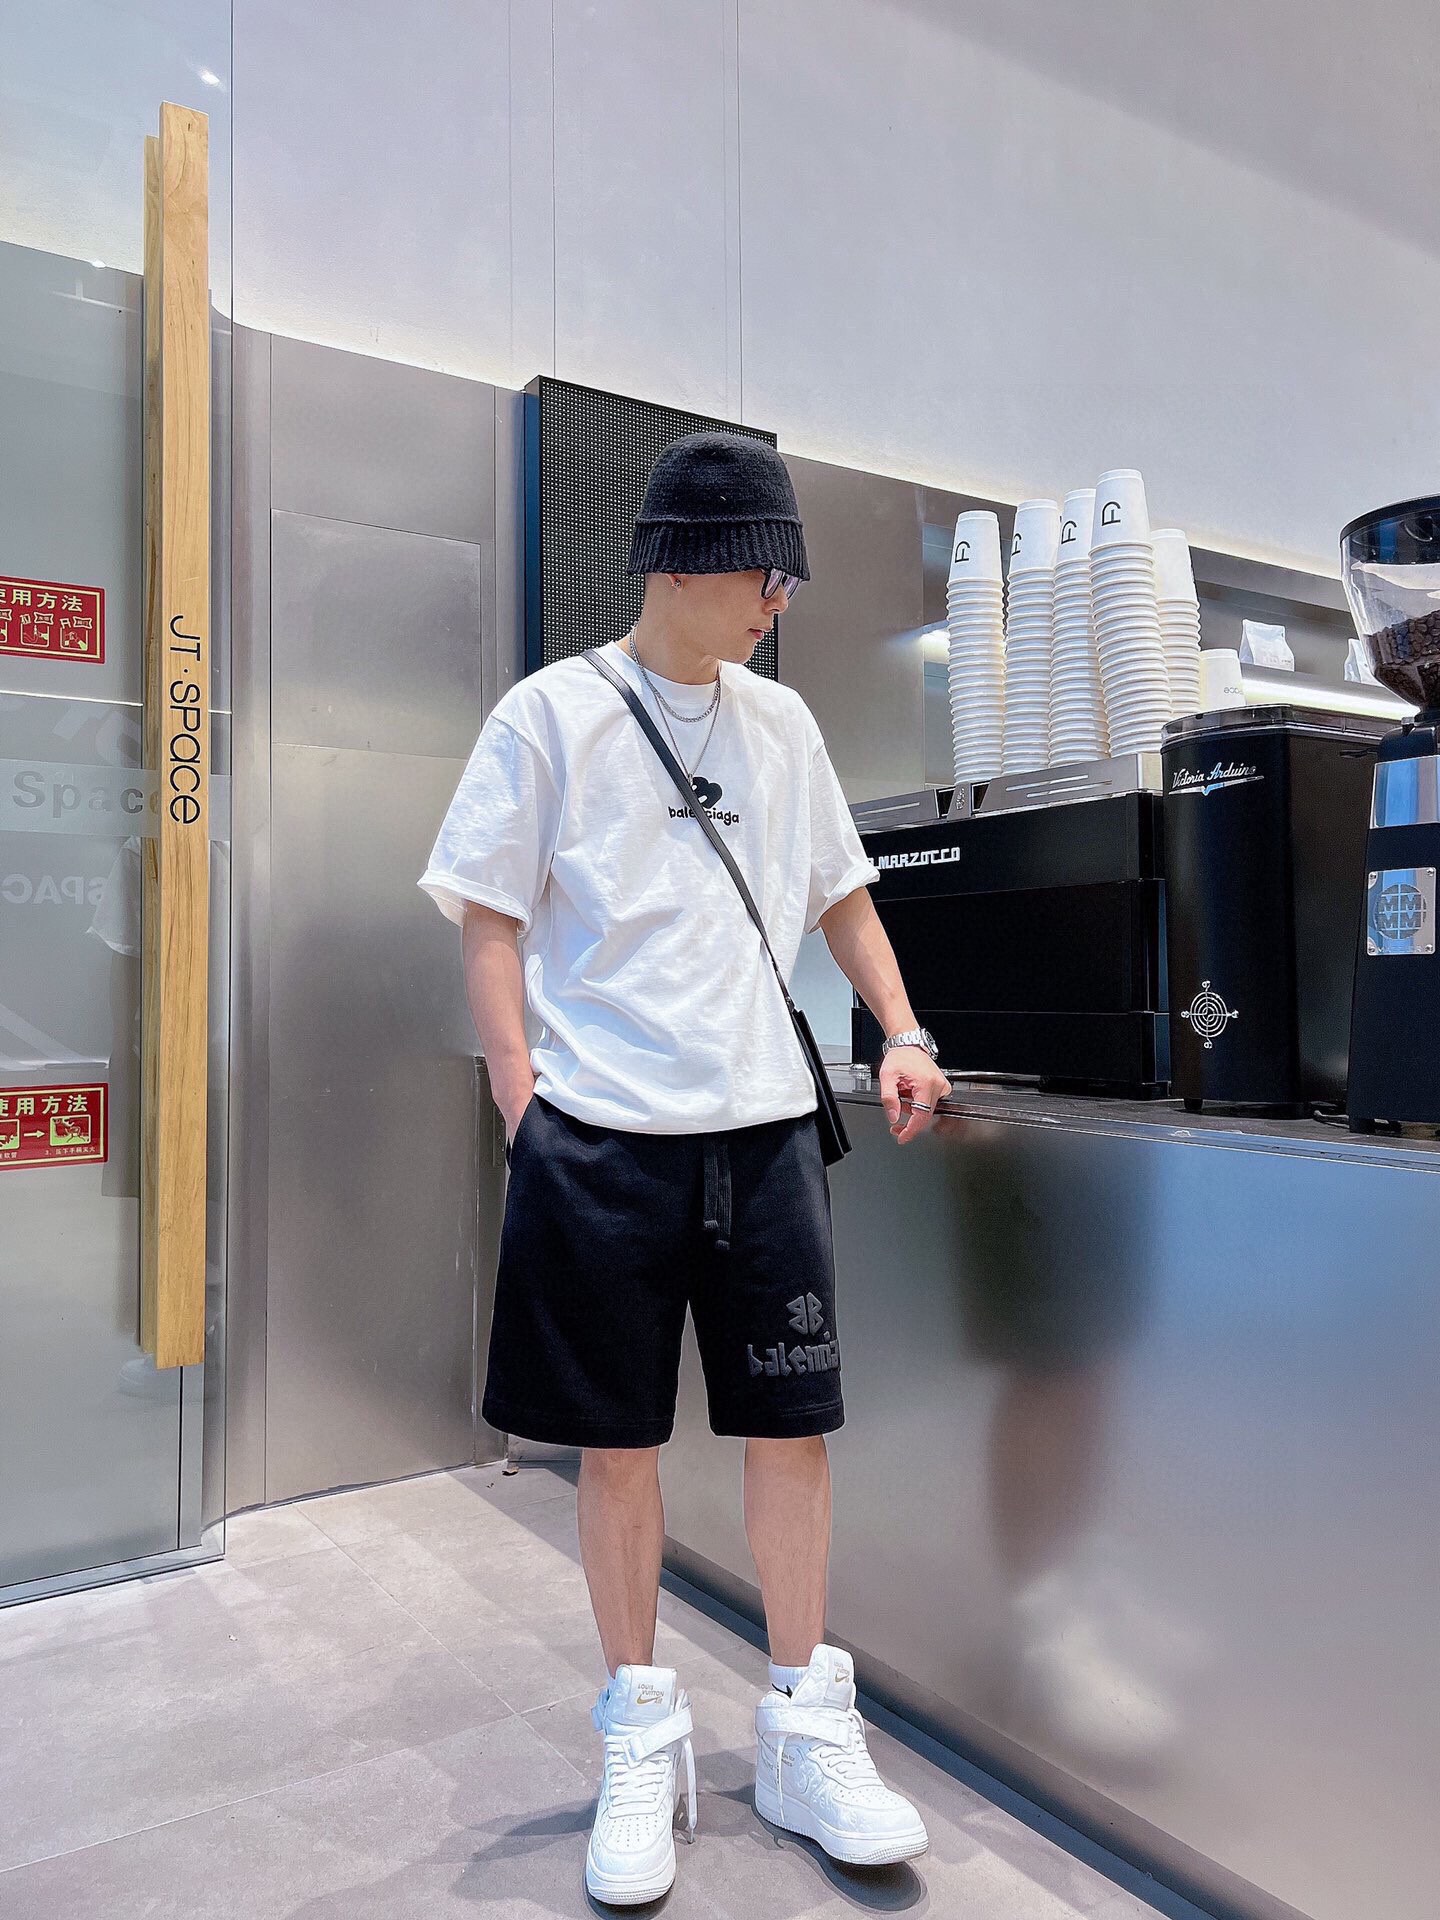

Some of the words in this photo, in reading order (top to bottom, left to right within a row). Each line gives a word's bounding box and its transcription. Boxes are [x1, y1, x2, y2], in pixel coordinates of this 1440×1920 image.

[1172, 768, 1205, 789] Victoria
[1207, 762, 1256, 781] Arduino
[668, 806, 740, 827] baleciaga
[879, 847, 960, 870] MARZOCCO
